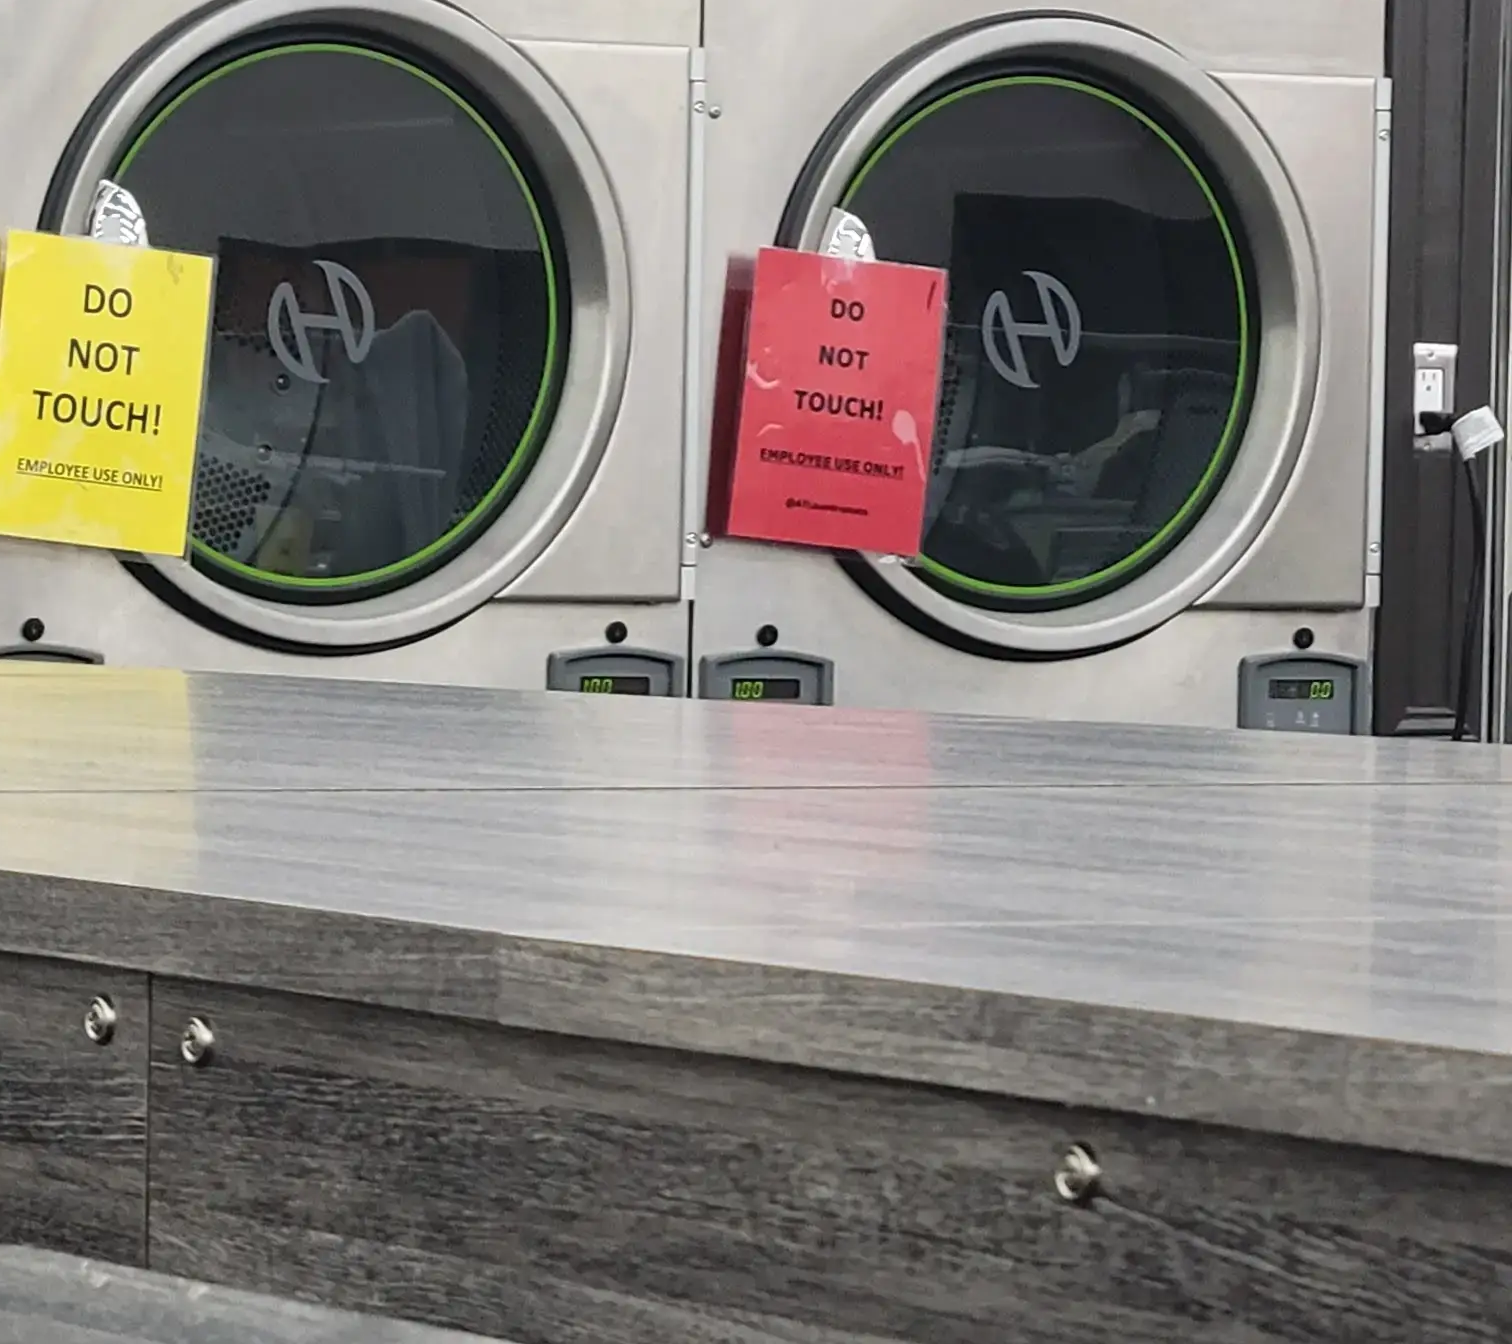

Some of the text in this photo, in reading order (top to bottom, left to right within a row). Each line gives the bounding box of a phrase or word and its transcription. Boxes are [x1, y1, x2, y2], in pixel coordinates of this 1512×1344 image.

[83, 284, 134, 318] DO
[830, 298, 866, 323] DO
[67, 337, 140, 376] NOT
[818, 344, 870, 371] NOT
[32, 389, 162, 436] TOUCH!
[792, 389, 884, 422] TOUCH!
[16, 457, 164, 490] EMPLOYEE USE ONLY!
